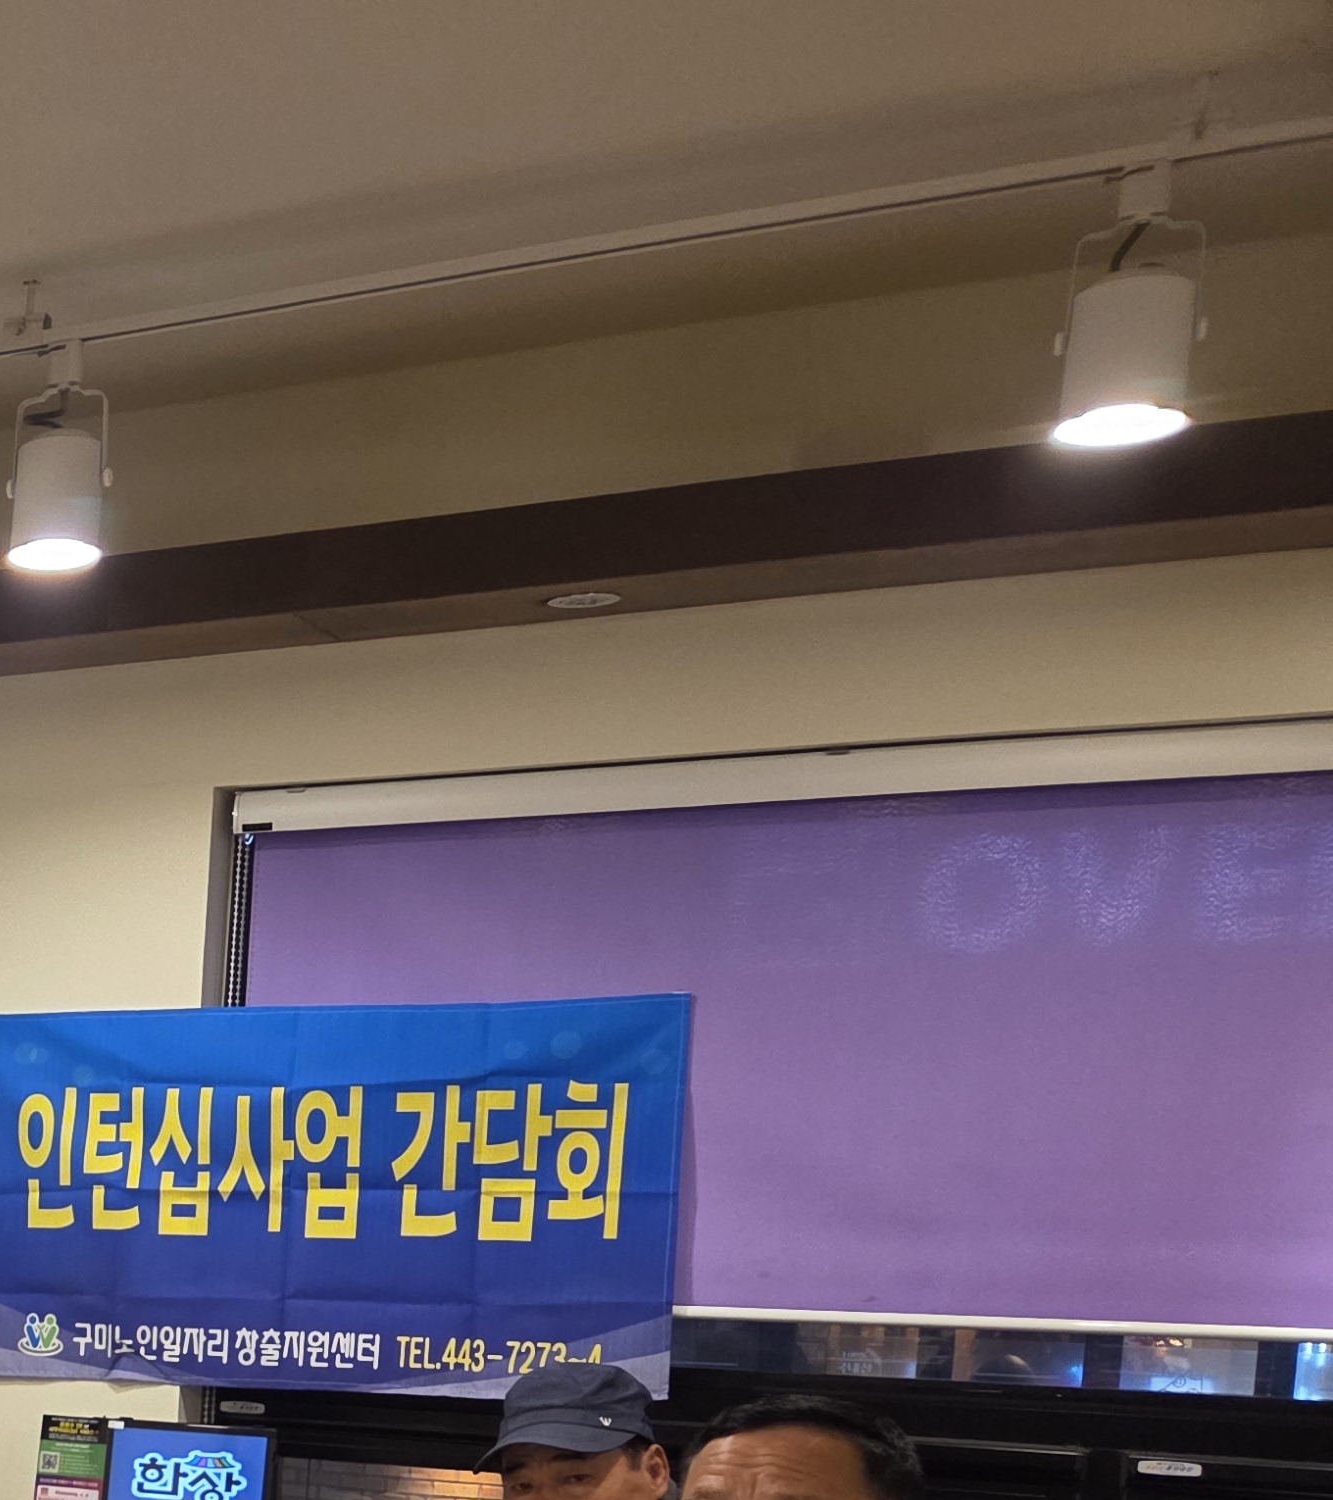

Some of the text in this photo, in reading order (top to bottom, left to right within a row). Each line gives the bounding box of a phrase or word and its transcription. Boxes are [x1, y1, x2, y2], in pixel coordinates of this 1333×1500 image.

[17, 1079, 630, 1242] 인턴십사업 간담회
[72, 1321, 230, 1365] 구미노인일자리
[234, 1326, 382, 1370] 창출지원센터
